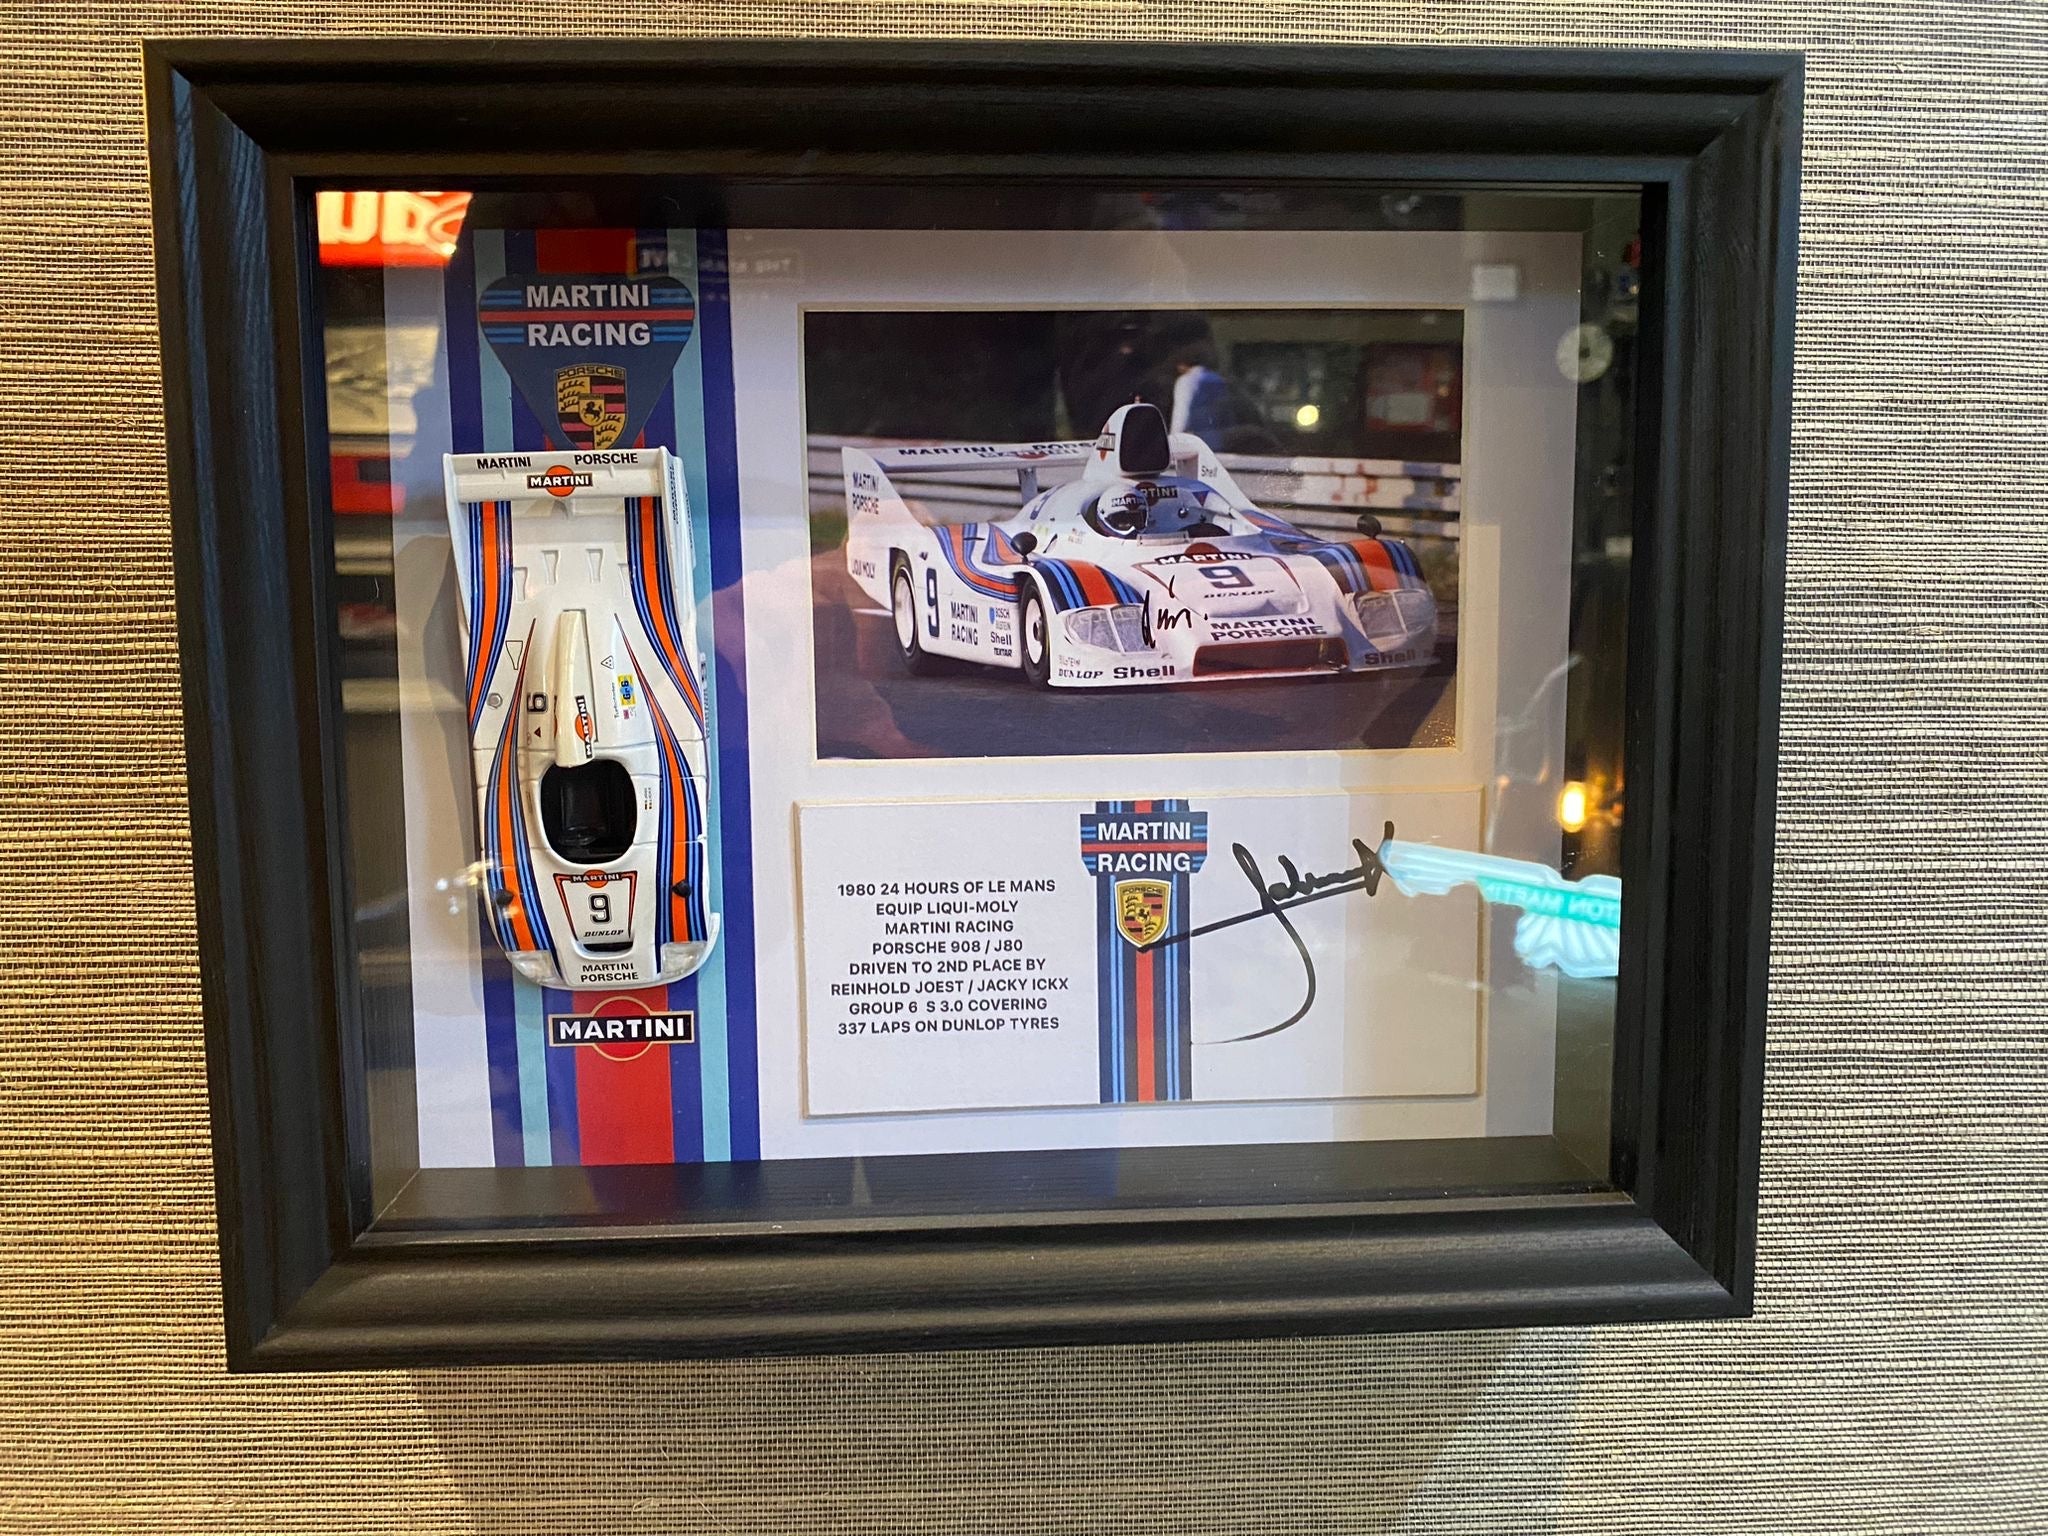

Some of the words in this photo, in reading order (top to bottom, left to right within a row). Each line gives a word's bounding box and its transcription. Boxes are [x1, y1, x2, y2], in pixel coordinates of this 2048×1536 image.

[526, 285, 649, 307] MARTINI
[528, 323, 651, 347] RACING
[557, 366, 625, 379] PORSCHE
[898, 446, 994, 456] MARTINI
[477, 457, 531, 469] MARTINI
[574, 453, 638, 465] PORSCHE
[530, 475, 589, 486] MARTINI
[853, 472, 879, 491] MARTINI
[852, 493, 879, 514] PORSCHE
[1157, 553, 1249, 565] MARTINI
[1200, 566, 1254, 588] 9
[926, 568, 940, 638] 9
[951, 601, 978, 624] MARTINI
[1211, 617, 1315, 630] MARTINI
[952, 624, 978, 646] RACING
[990, 631, 1012, 646] Shell
[1212, 626, 1327, 641] PORSCHE
[1365, 652, 1415, 665] Shell
[1058, 668, 1104, 679] DUNLOP
[1113, 665, 1175, 679] Shell
[577, 698, 592, 757] MARTINI
[1099, 822, 1190, 840] MARTINI
[1099, 853, 1190, 872] RACING
[572, 873, 620, 882] MARTINI
[838, 884, 875, 896] 1980
[881, 883, 899, 895] 24
[905, 882, 959, 894] HOURS
[964, 881, 983, 893] OF
[989, 881, 1005, 892] LE
[1011, 880, 1055, 892] MANS
[589, 893, 611, 923] 9
[877, 903, 922, 916] EQUIP
[928, 901, 1018, 914] LIQUI-MOLY
[584, 929, 624, 938] DUNLOP
[886, 922, 950, 934] MARTINI
[956, 920, 1013, 933] RACING
[873, 942, 946, 954] PORSCHE
[951, 941, 980, 952] 908
[985, 940, 990, 954] /
[995, 940, 1022, 951] J80
[583, 963, 634, 972] MARTINI
[850, 962, 906, 975] DRIVEN
[912, 962, 932, 973] TO
[938, 961, 967, 972] 2ND
[973, 959, 1021, 971] PLACE
[1027, 959, 1045, 970] BY
[581, 972, 639, 982] PORSCHE
[832, 982, 910, 995] REINHOLD
[915, 981, 963, 993] JOEST
[968, 980, 973, 994] /
[978, 979, 1027, 991] JACKY
[1033, 978, 1068, 990] ICKX
[850, 1002, 903, 1015] GROUP
[909, 1002, 917, 1013] 6
[927, 1001, 935, 1012] S
[941, 1000, 963, 1012] 3.0
[969, 998, 1047, 1011] COVERING
[560, 1017, 685, 1040] MARTINI
[839, 1023, 866, 1034] 337
[872, 1021, 910, 1033] LAPS
[915, 1020, 937, 1032] ON
[943, 1019, 1004, 1031] DUNLOP
[1010, 1017, 1058, 1029] TYRES
